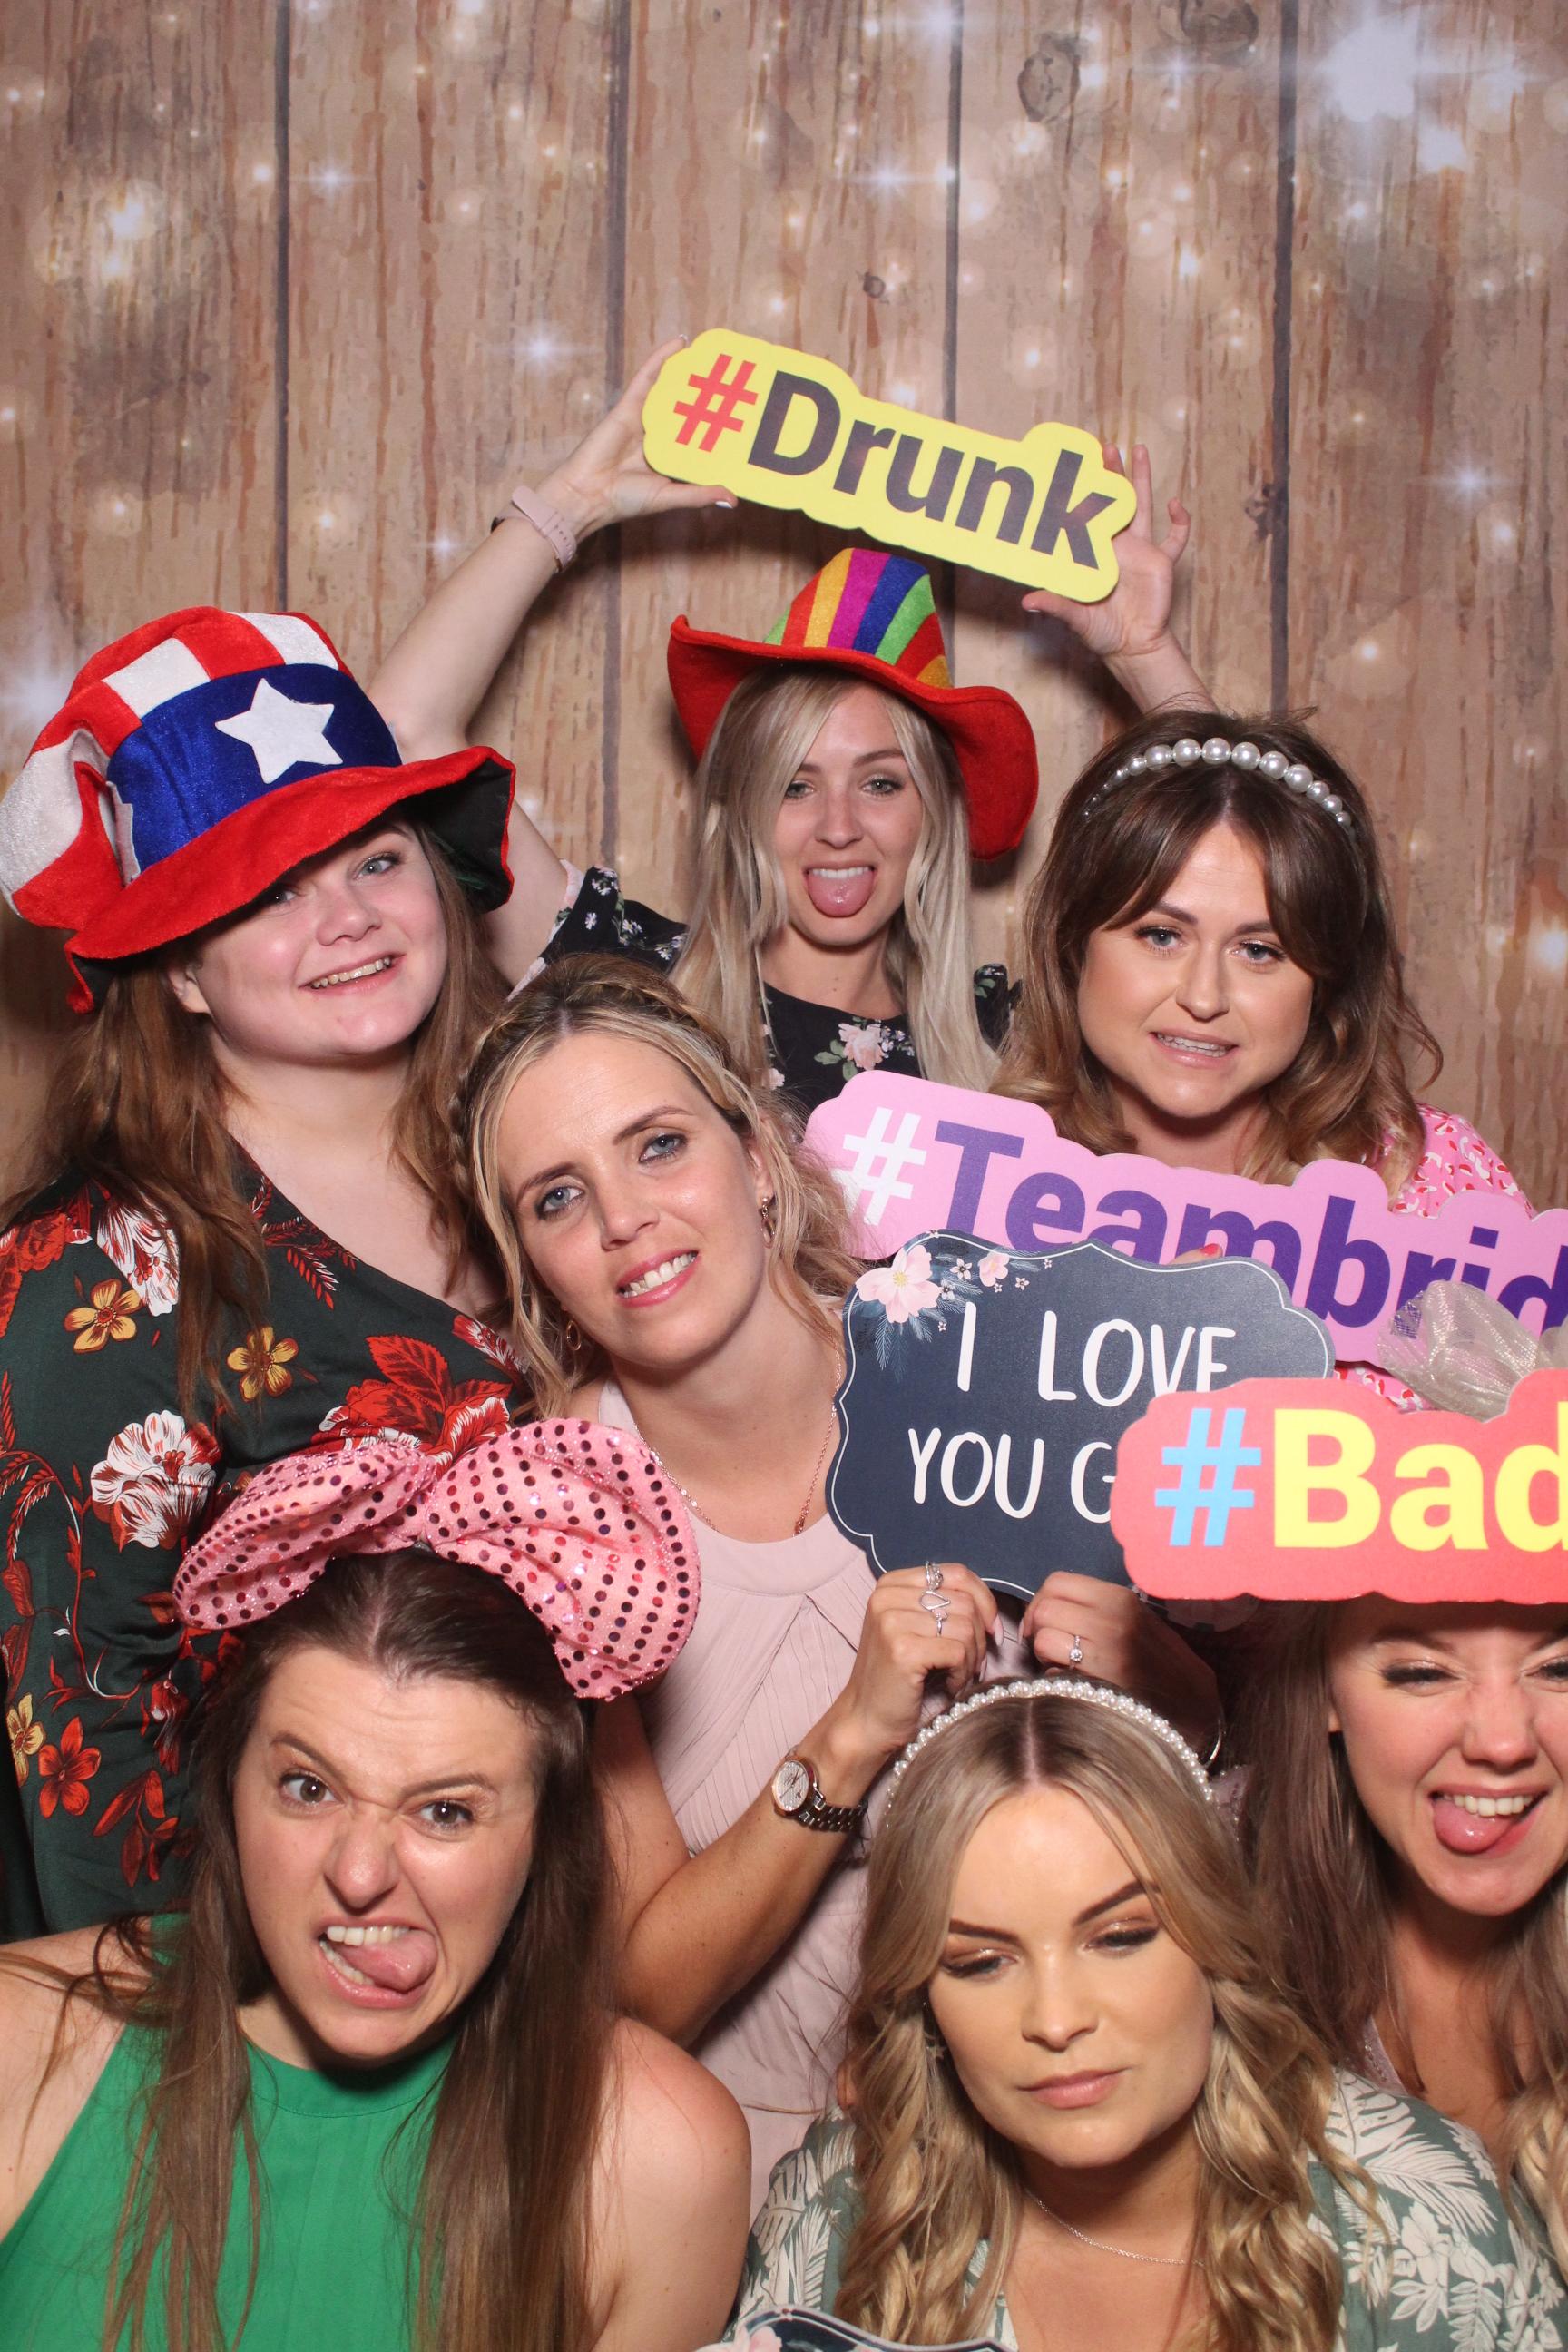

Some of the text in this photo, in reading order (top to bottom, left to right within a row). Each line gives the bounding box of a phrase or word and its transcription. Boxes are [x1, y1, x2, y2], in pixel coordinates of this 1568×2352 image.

[672, 352, 1117, 570] #Drunk
[956, 1301, 1237, 1407] I LOVE
[907, 1426, 1044, 1520] YOU
[1154, 1400, 1568, 1553] #Bad
